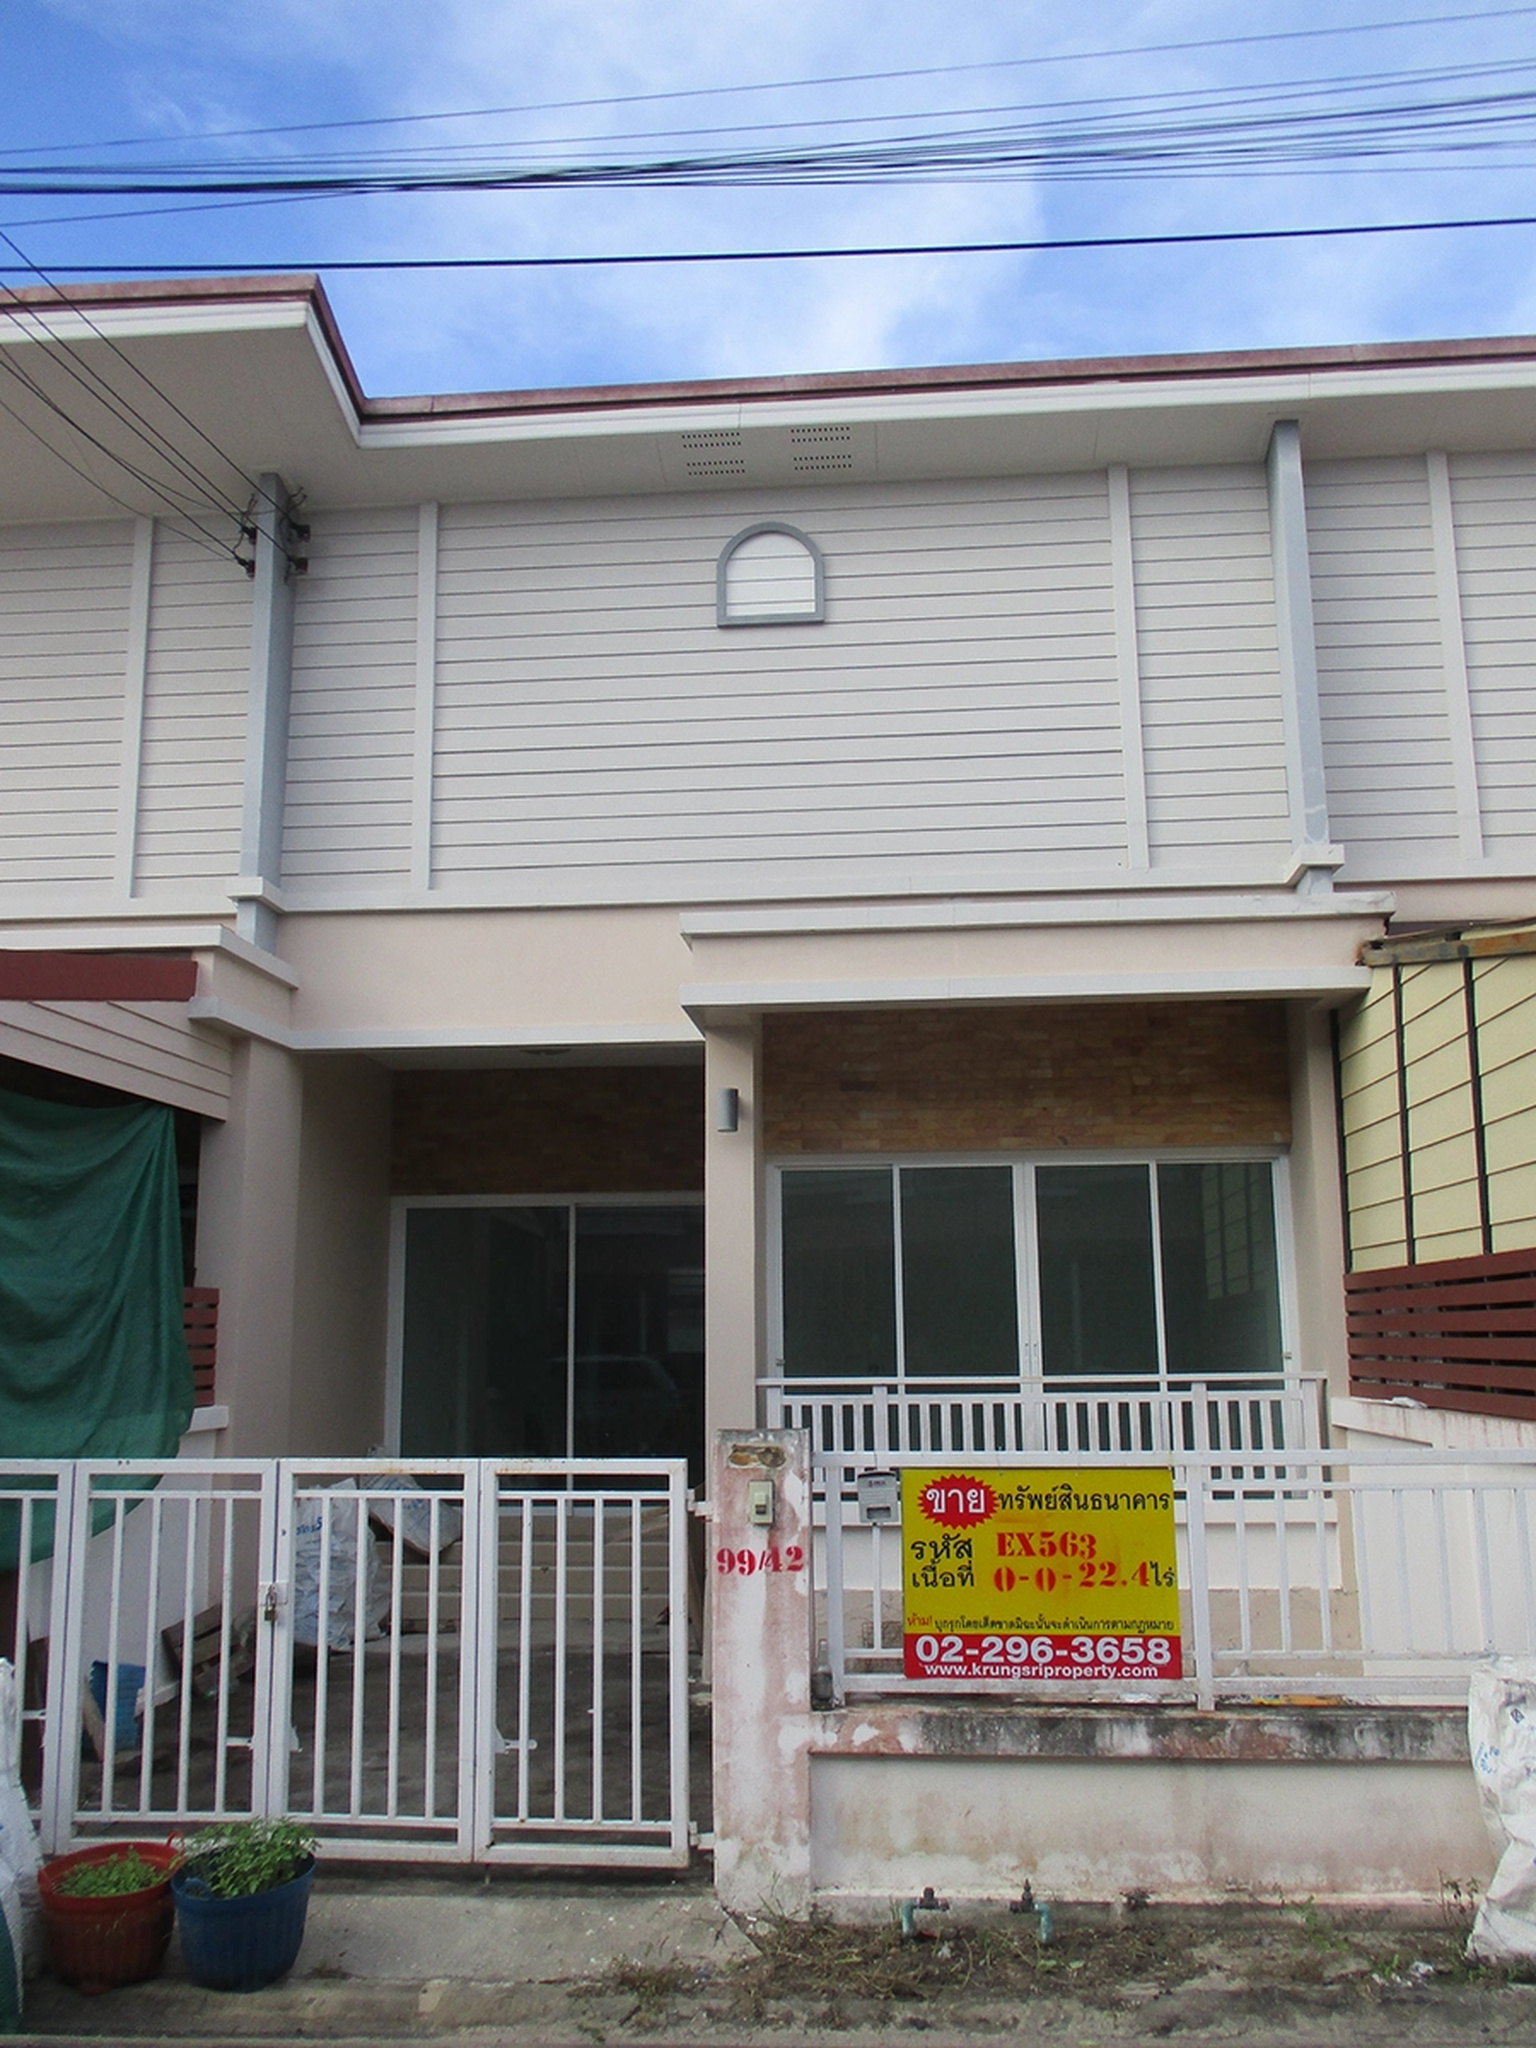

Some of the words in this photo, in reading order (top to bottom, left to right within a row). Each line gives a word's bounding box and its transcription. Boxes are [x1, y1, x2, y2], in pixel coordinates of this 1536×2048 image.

[926, 1488, 985, 1513] ขาย
[998, 1483, 1170, 1511] ทรัพย์สินธนาคาร
[716, 1546, 804, 1575] 99/42
[910, 1533, 973, 1560] รหัส
[996, 1532, 1096, 1559] EX563
[912, 1558, 974, 1587] เนื้อที่
[915, 1635, 1172, 1664] 02-296-3658
[924, 1662, 1158, 1679] www.krungsriproperty.com
